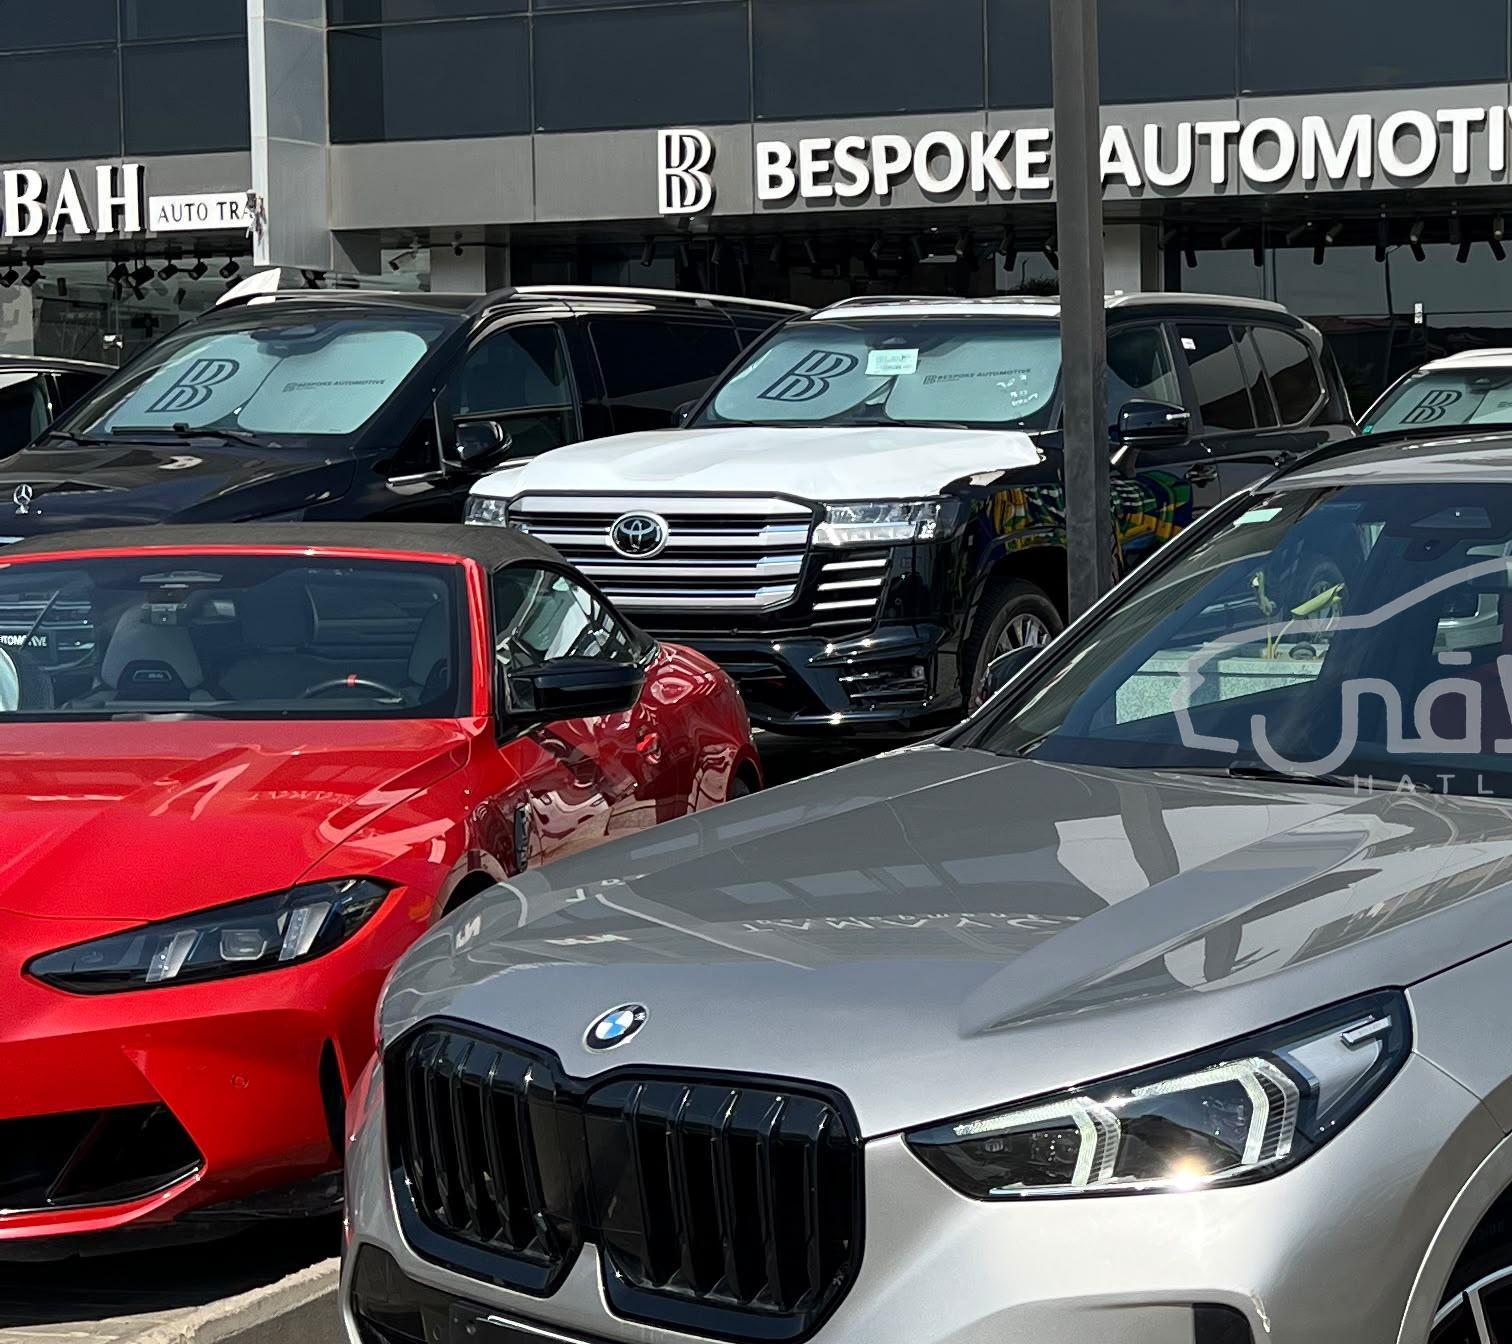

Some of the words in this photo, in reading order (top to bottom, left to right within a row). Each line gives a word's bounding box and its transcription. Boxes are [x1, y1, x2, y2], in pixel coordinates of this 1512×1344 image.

[3, 163, 143, 237] BAH
[158, 202, 208, 223] AUTO
[757, 127, 1052, 201] BESPOKE
